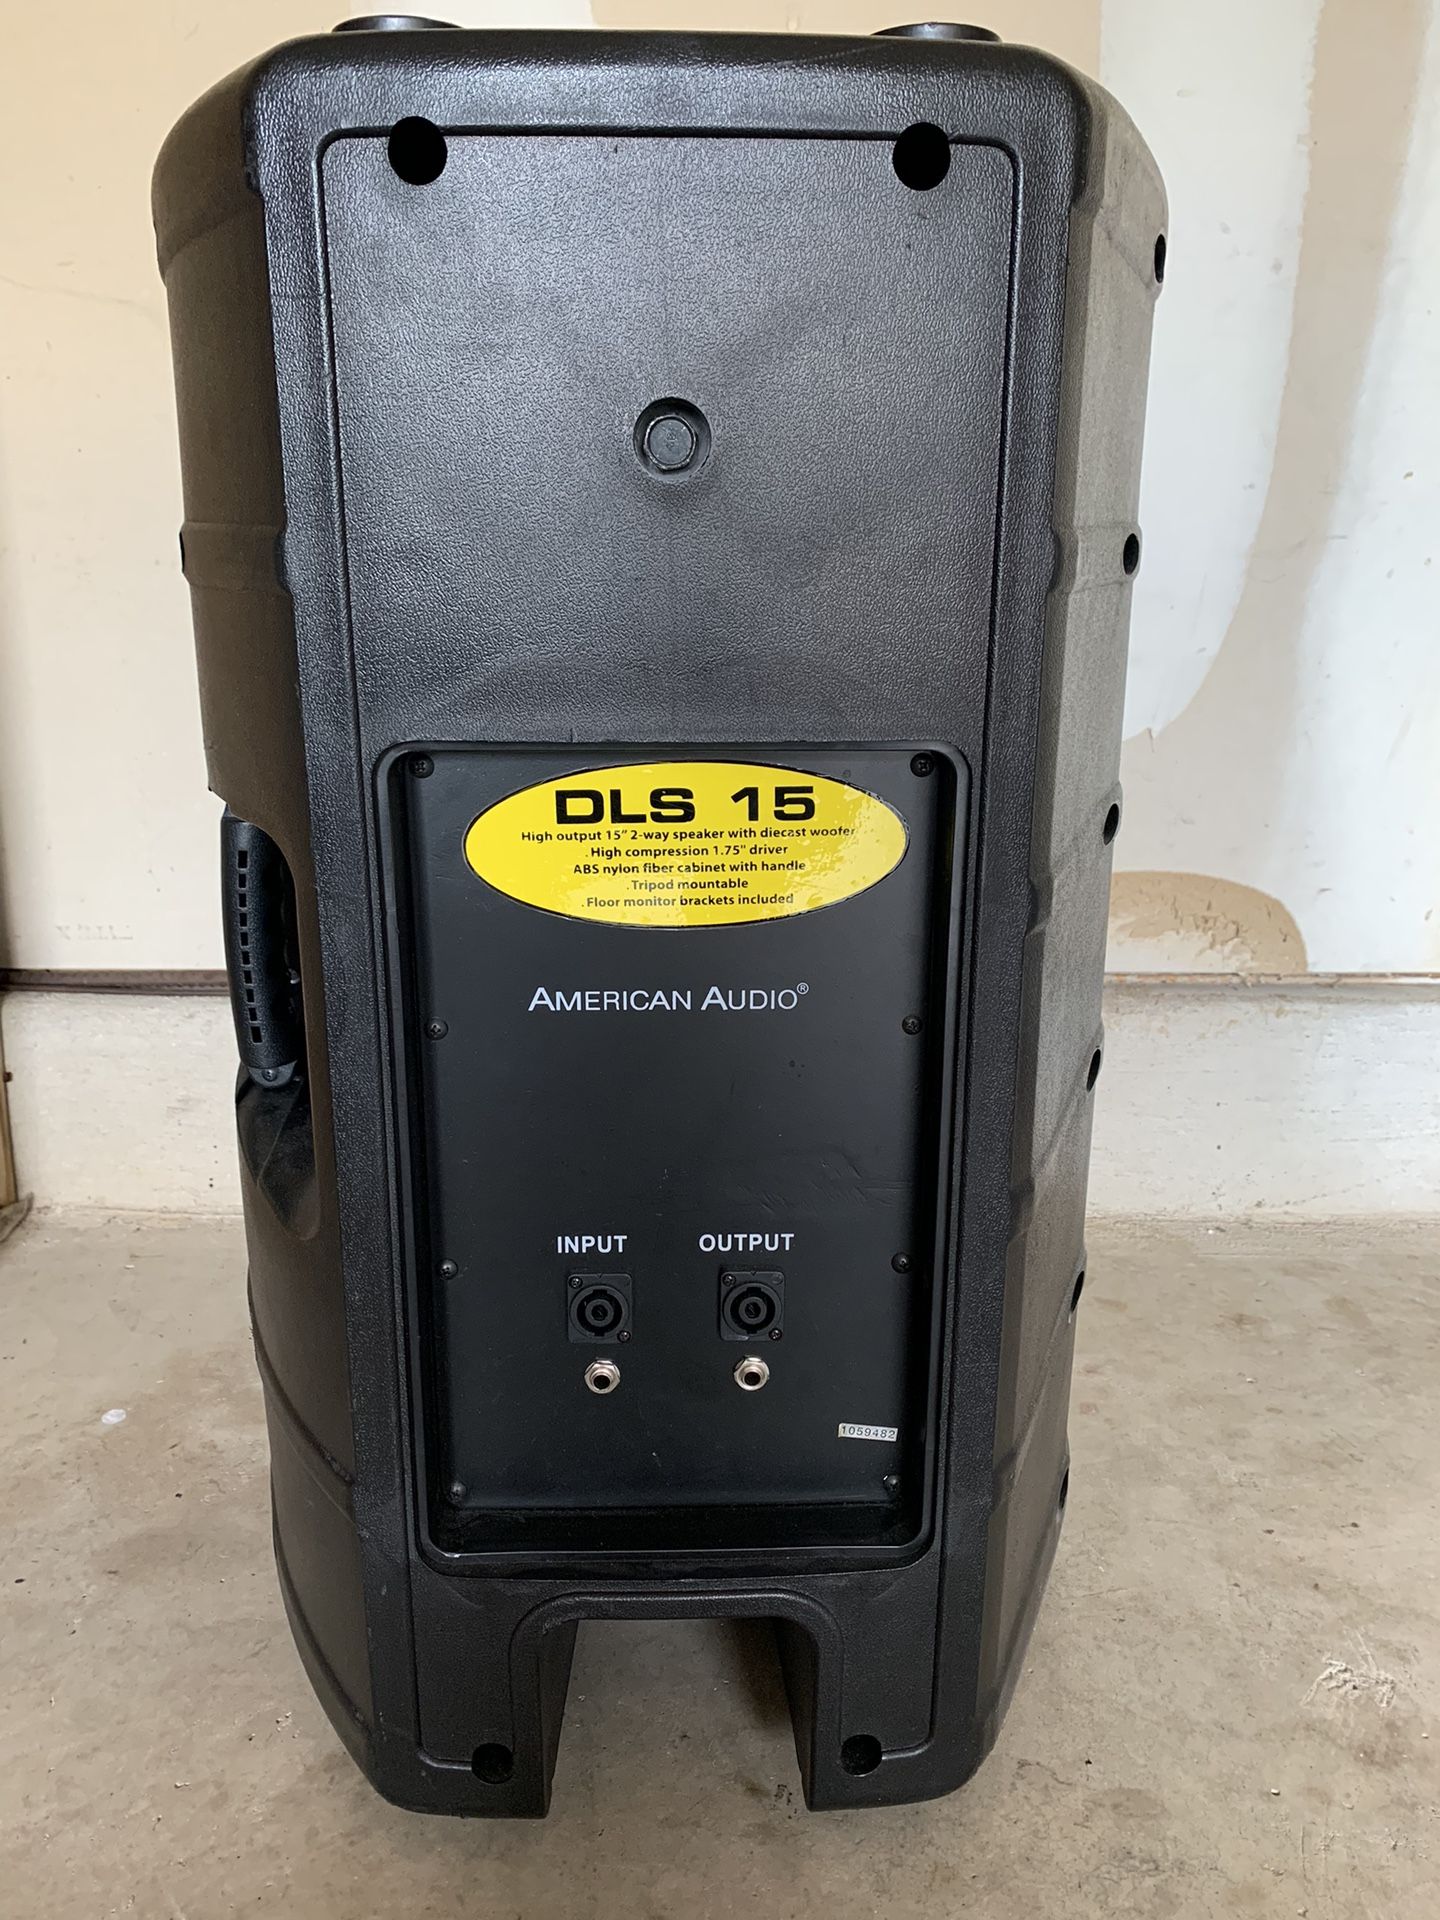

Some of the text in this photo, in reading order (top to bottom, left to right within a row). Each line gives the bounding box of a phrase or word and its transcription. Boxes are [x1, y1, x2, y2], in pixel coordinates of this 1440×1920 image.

[555, 786, 815, 824] DLS 15
[521, 830, 553, 844] High
[556, 829, 602, 843] output
[630, 829, 669, 842] 2-way
[672, 828, 725, 842] speaker
[728, 827, 757, 839] with
[760, 826, 807, 838] diecast
[810, 825, 856, 837] woofer
[591, 844, 789, 860] High compression 1.75" driver
[573, 860, 806, 877] ABS nylon fiber cabinet with handle
[631, 877, 749, 893] Tripod mountable
[586, 893, 795, 908] Floor monitor brackets included
[528, 986, 691, 1011] AMERICAN
[556, 1235, 628, 1253] INPUT
[698, 1233, 796, 1251] OUTPUT
[841, 1425, 896, 1439] 1059482
